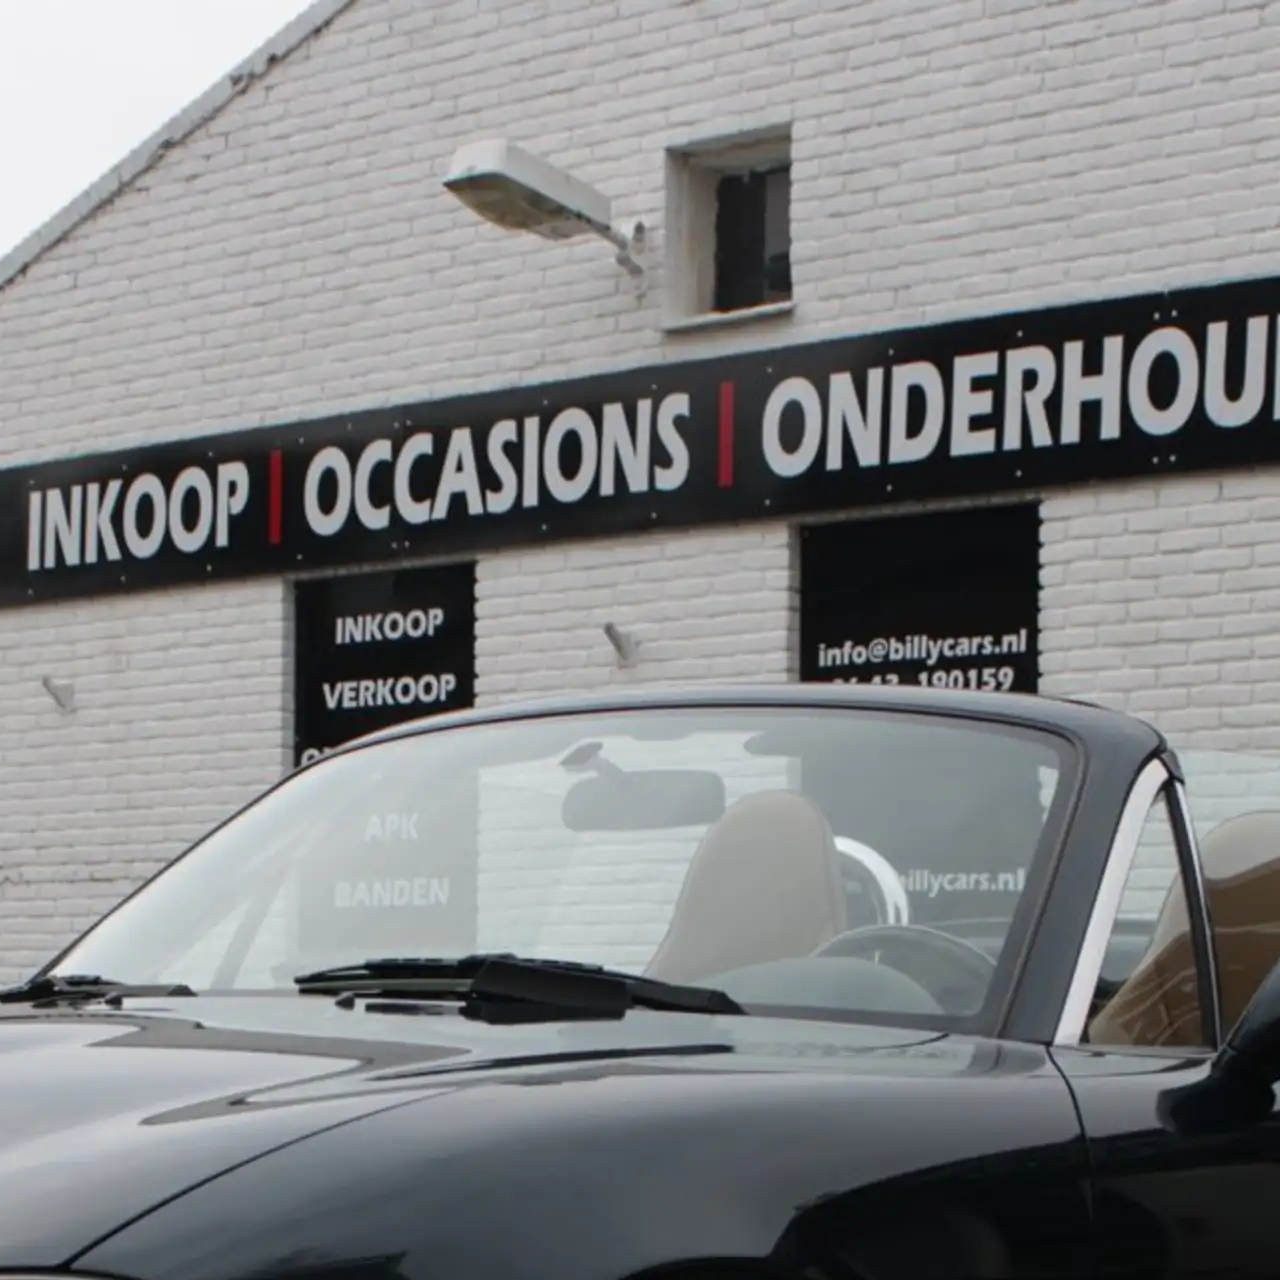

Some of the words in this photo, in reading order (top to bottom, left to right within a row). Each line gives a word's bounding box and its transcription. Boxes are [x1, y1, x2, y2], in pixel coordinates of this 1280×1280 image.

[27, 461, 250, 571] INKOOP
[304, 393, 689, 536] OCCASIONS
[335, 608, 444, 644] INKOOP
[818, 628, 1028, 667] info@billycars.nl
[322, 674, 456, 710] VERKOOP
[363, 812, 419, 841] APK
[333, 877, 450, 908] BANDEN
